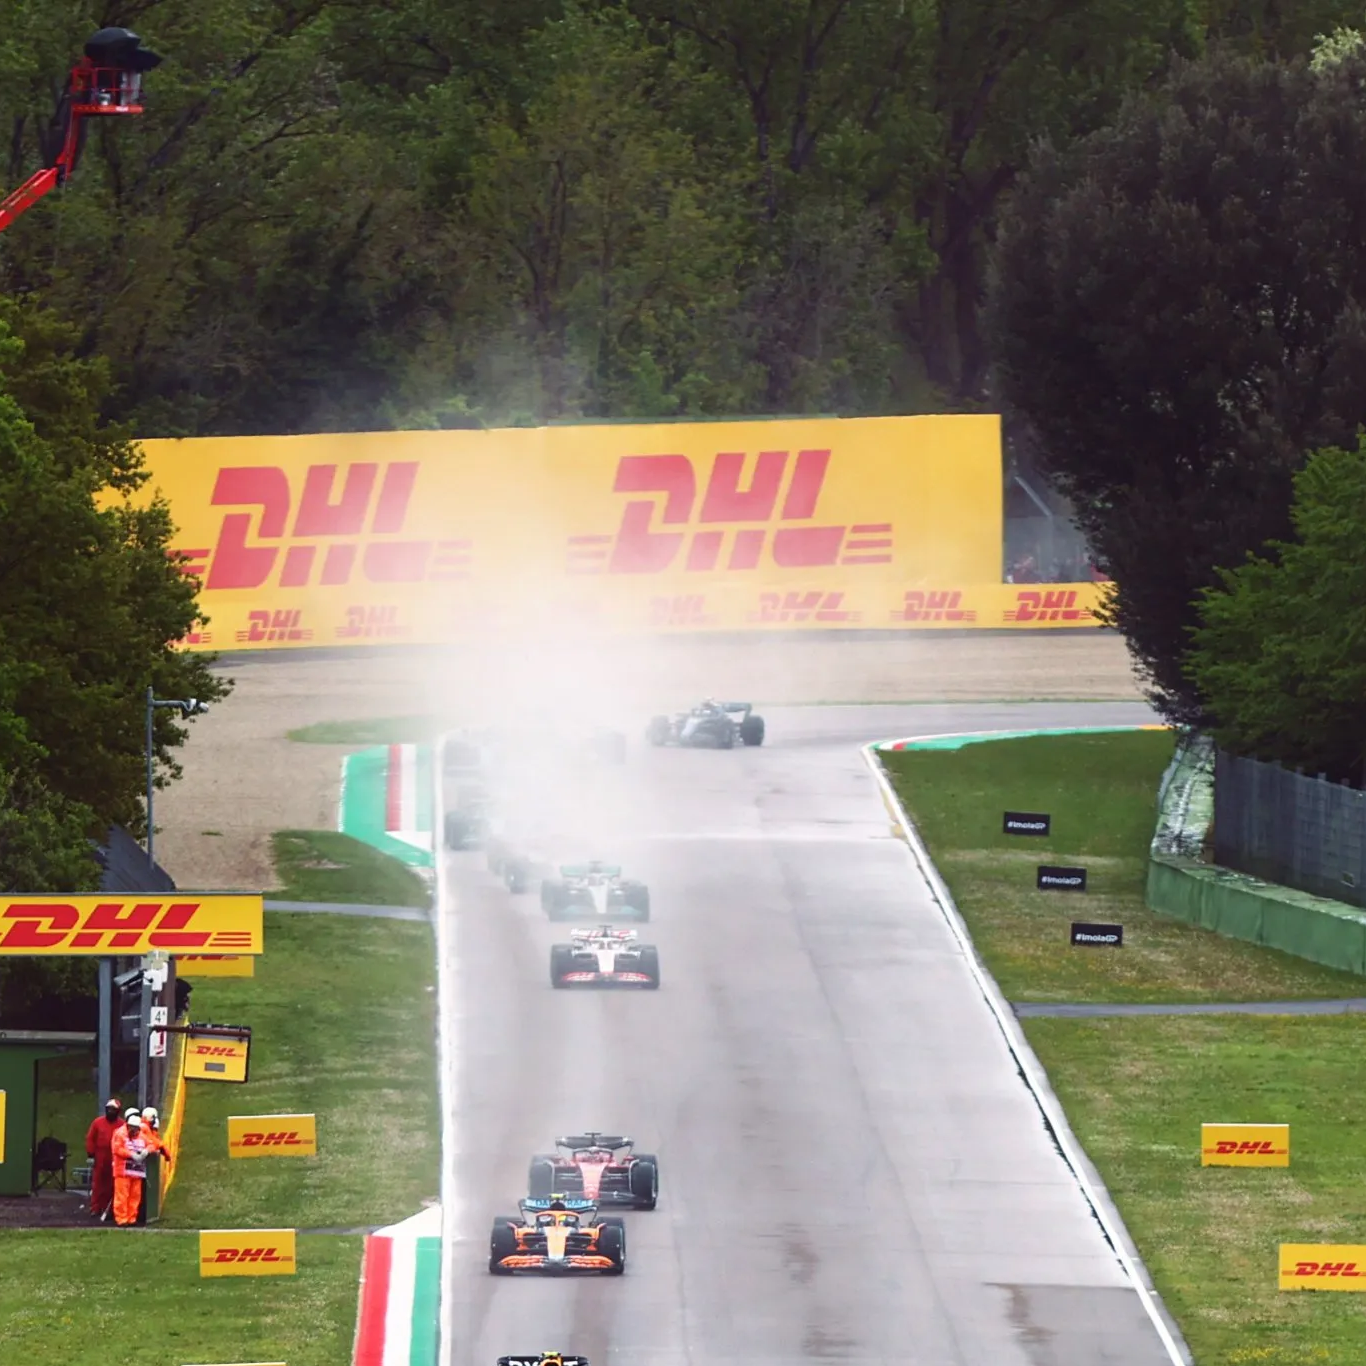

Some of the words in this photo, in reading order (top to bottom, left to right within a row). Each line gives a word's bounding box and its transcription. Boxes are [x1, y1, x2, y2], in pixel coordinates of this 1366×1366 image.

[206, 462, 433, 589] DHL
[607, 449, 846, 575] DHL
[248, 609, 302, 642] DHL
[757, 591, 848, 622] DHL
[902, 590, 965, 621] DHL
[1016, 590, 1081, 621] DHL
[196, 1045, 237, 1057] DHL
[241, 1131, 303, 1147] DHL
[1216, 1140, 1277, 1155] DHL
[214, 1247, 282, 1263] DHL
[1295, 1261, 1361, 1278] DHL
